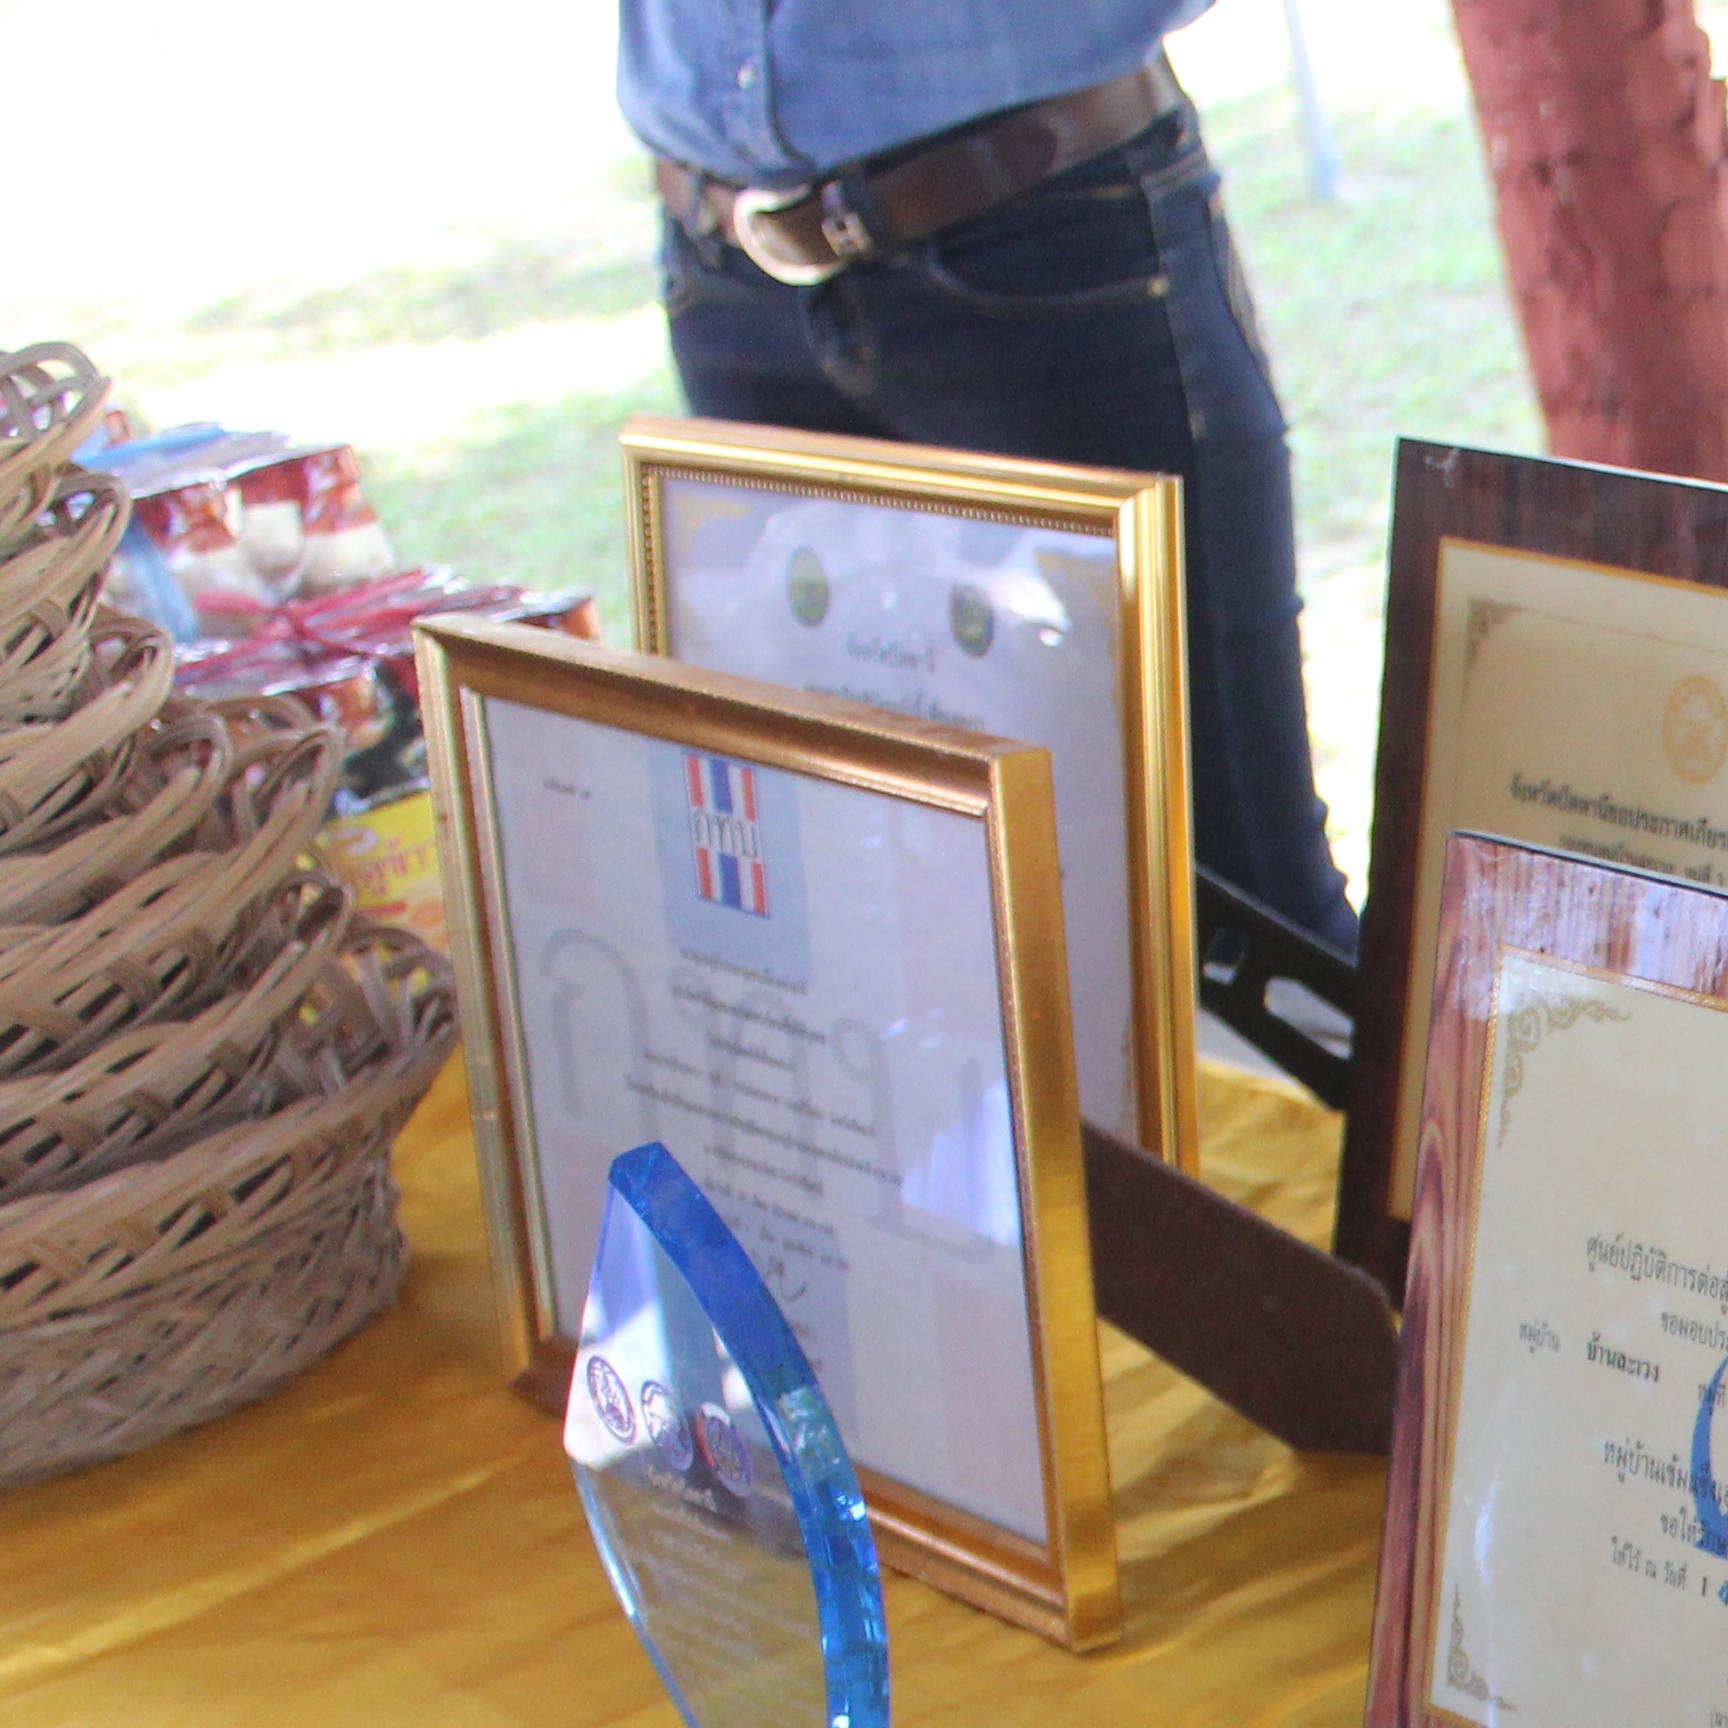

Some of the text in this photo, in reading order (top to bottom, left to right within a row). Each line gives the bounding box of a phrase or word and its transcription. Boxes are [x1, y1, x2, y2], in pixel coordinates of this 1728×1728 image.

[1519, 1320, 1560, 1355] หมู่บ้าน
[1586, 1331, 1660, 1383] บ้านละเวง
[1611, 1535, 1642, 1572] ให้ไว้
[1645, 1560, 1657, 1580] ณ
[1664, 1561, 1688, 1590] วันที่
